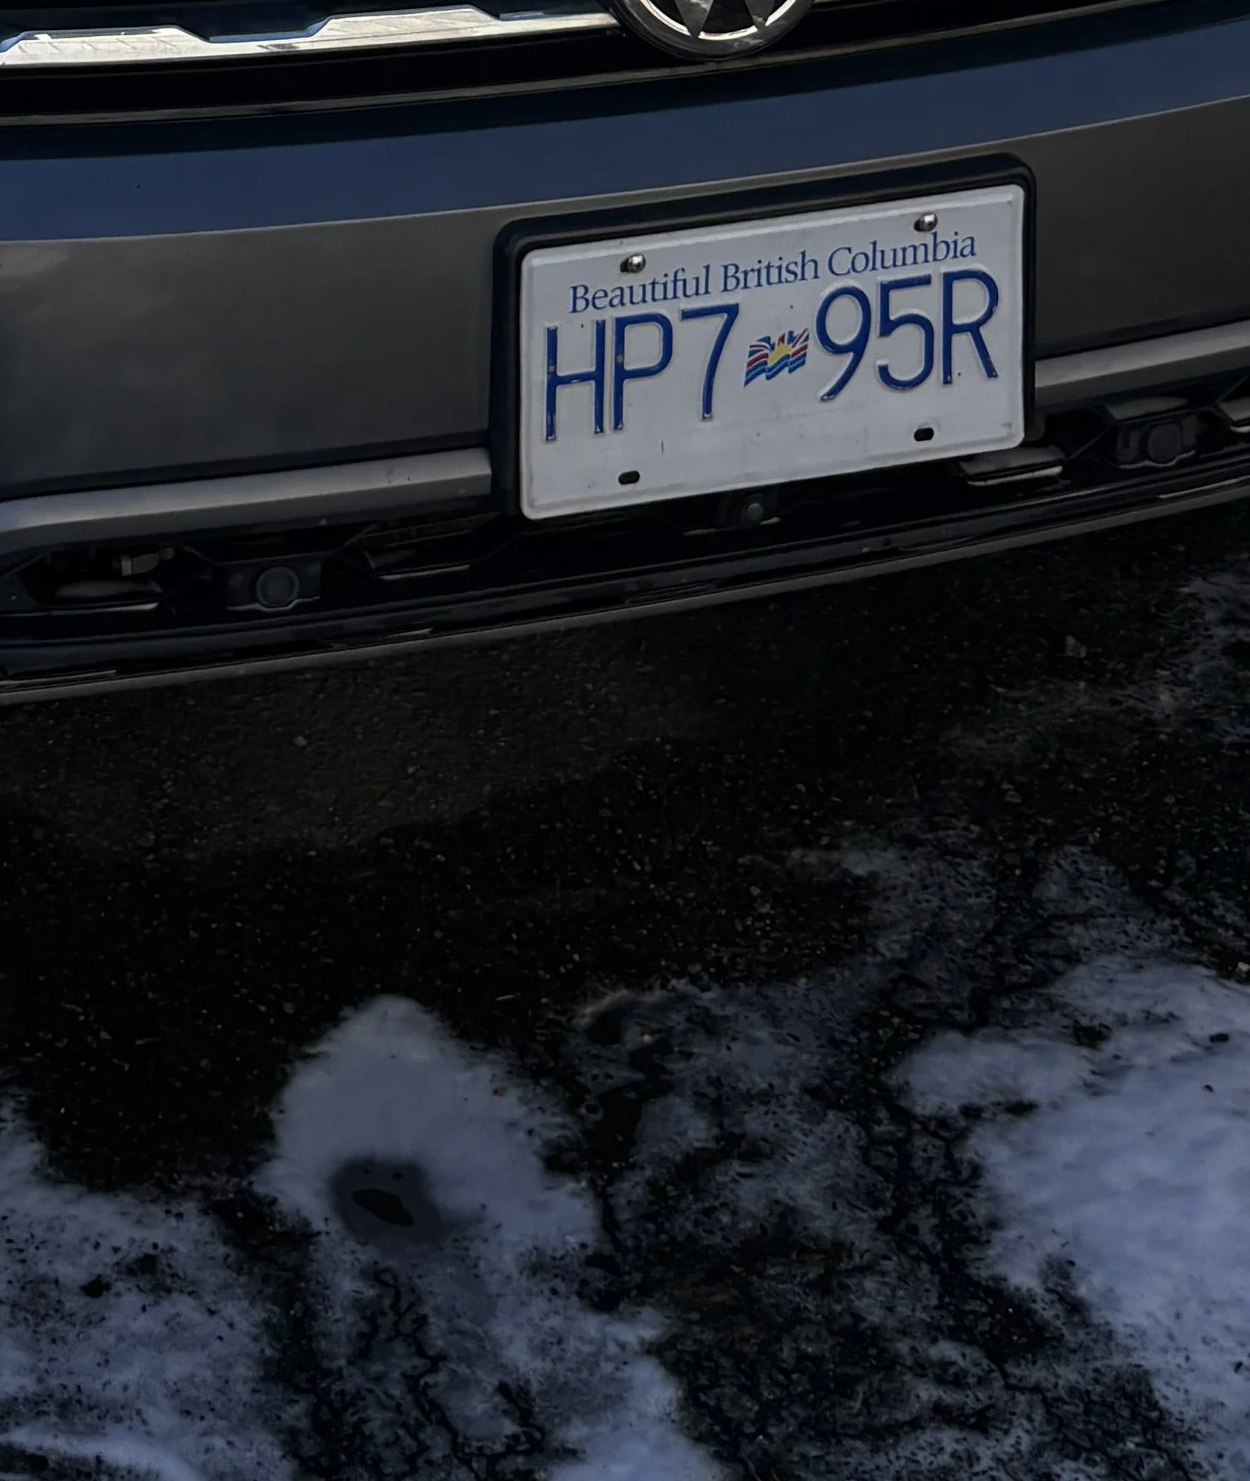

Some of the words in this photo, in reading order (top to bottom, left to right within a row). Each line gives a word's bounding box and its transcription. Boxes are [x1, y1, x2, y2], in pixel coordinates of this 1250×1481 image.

[569, 265, 711, 314] Beautiful
[721, 249, 820, 293] British
[827, 230, 977, 277] Columbia
[545, 302, 740, 441] HP7
[815, 268, 1000, 401] 95R
